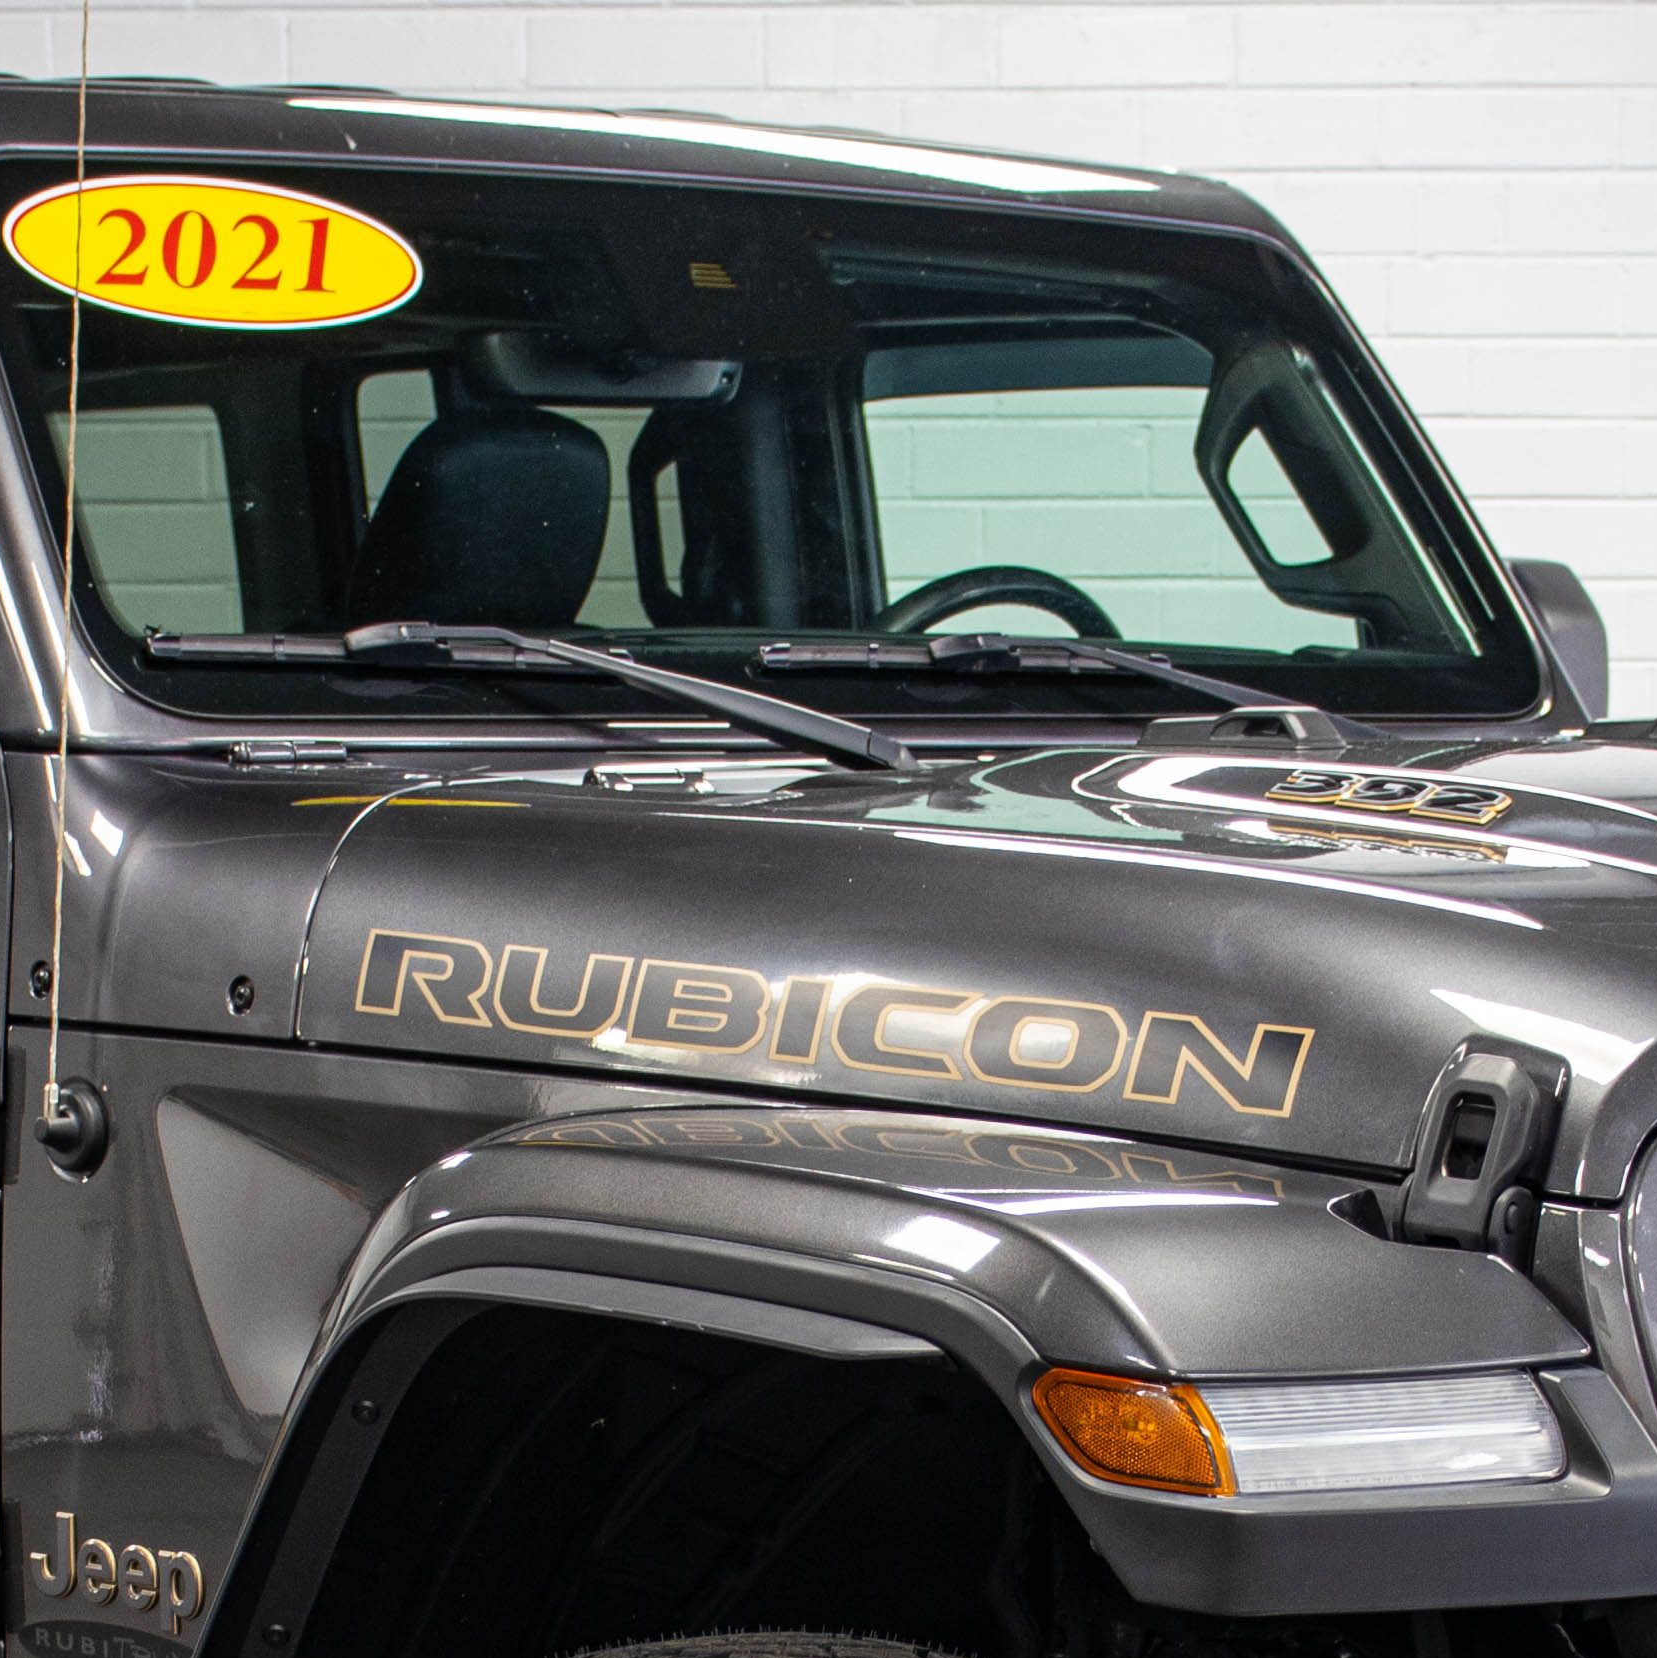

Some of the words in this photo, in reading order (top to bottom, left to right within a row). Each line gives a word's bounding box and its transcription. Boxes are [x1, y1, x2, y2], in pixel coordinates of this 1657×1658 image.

[96, 208, 336, 293] 2021
[1264, 768, 1512, 825] 392
[355, 928, 1315, 1119] RUBICON
[29, 1511, 204, 1636] Jeep
